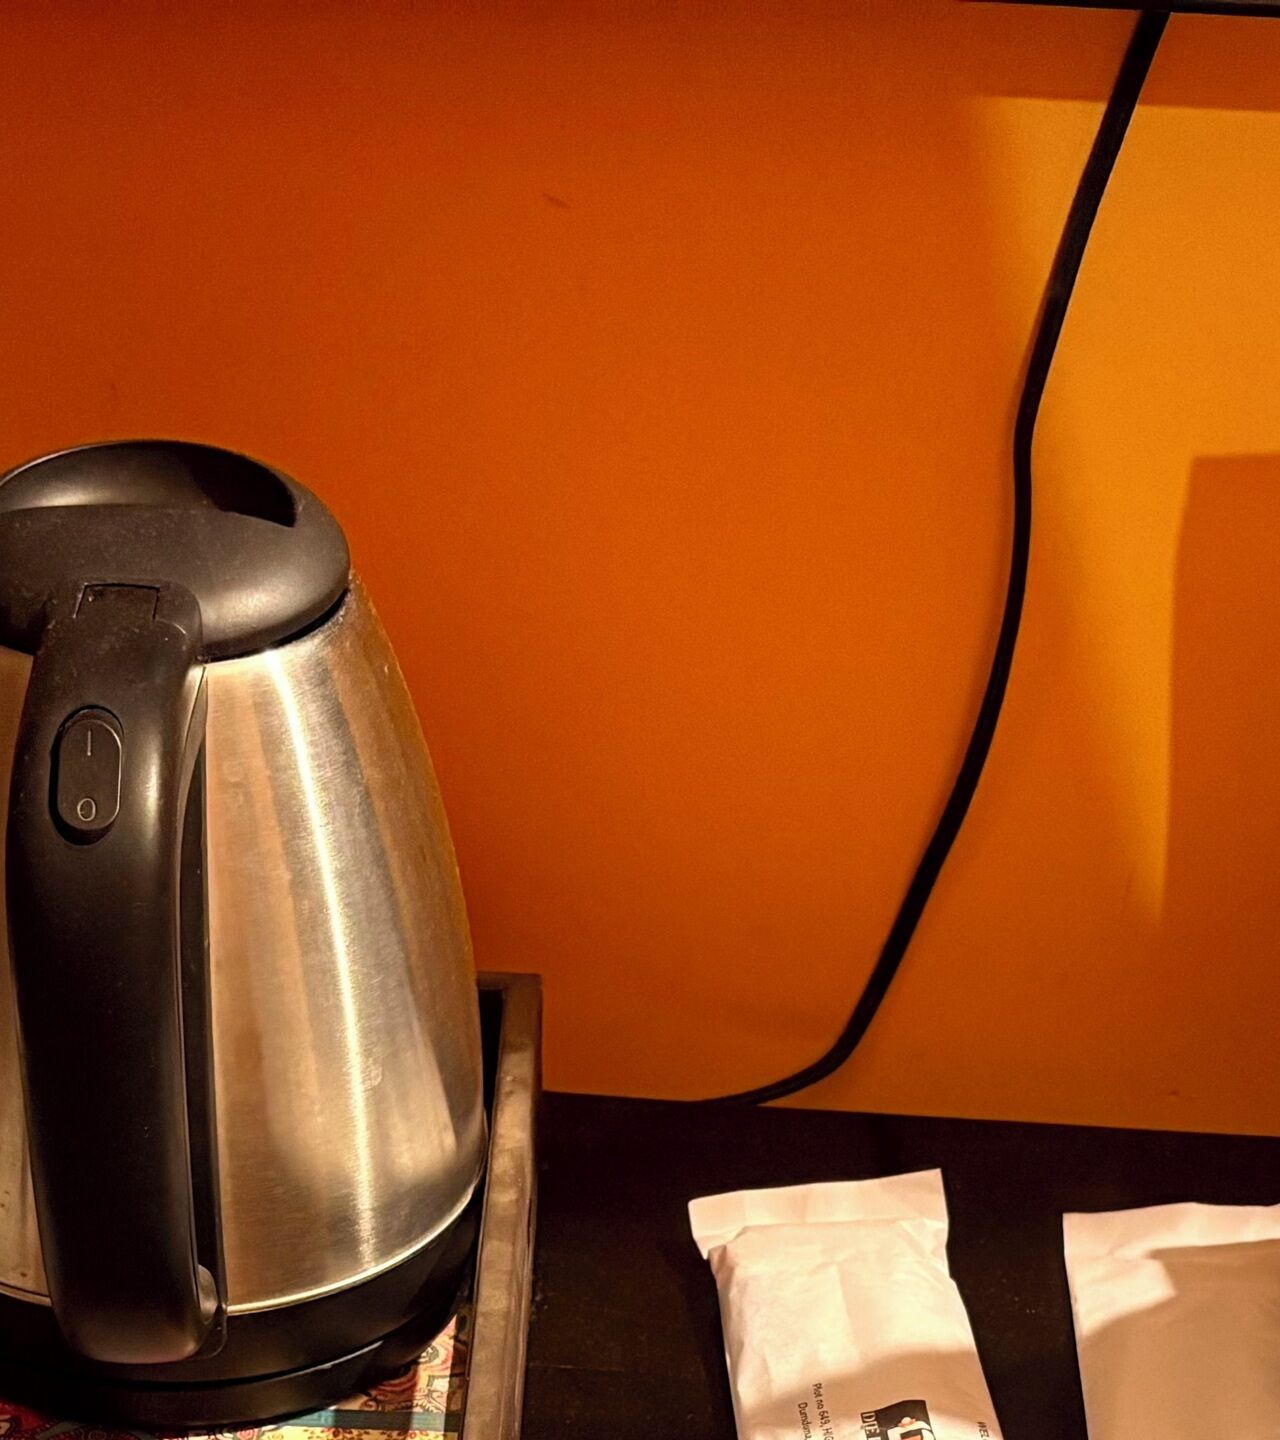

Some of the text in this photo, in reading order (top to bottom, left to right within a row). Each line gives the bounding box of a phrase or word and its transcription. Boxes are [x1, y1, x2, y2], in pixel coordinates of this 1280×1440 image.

[813, 1382, 824, 1398] Plot
[817, 1398, 826, 1409] no
[819, 1410, 830, 1428] 649,
